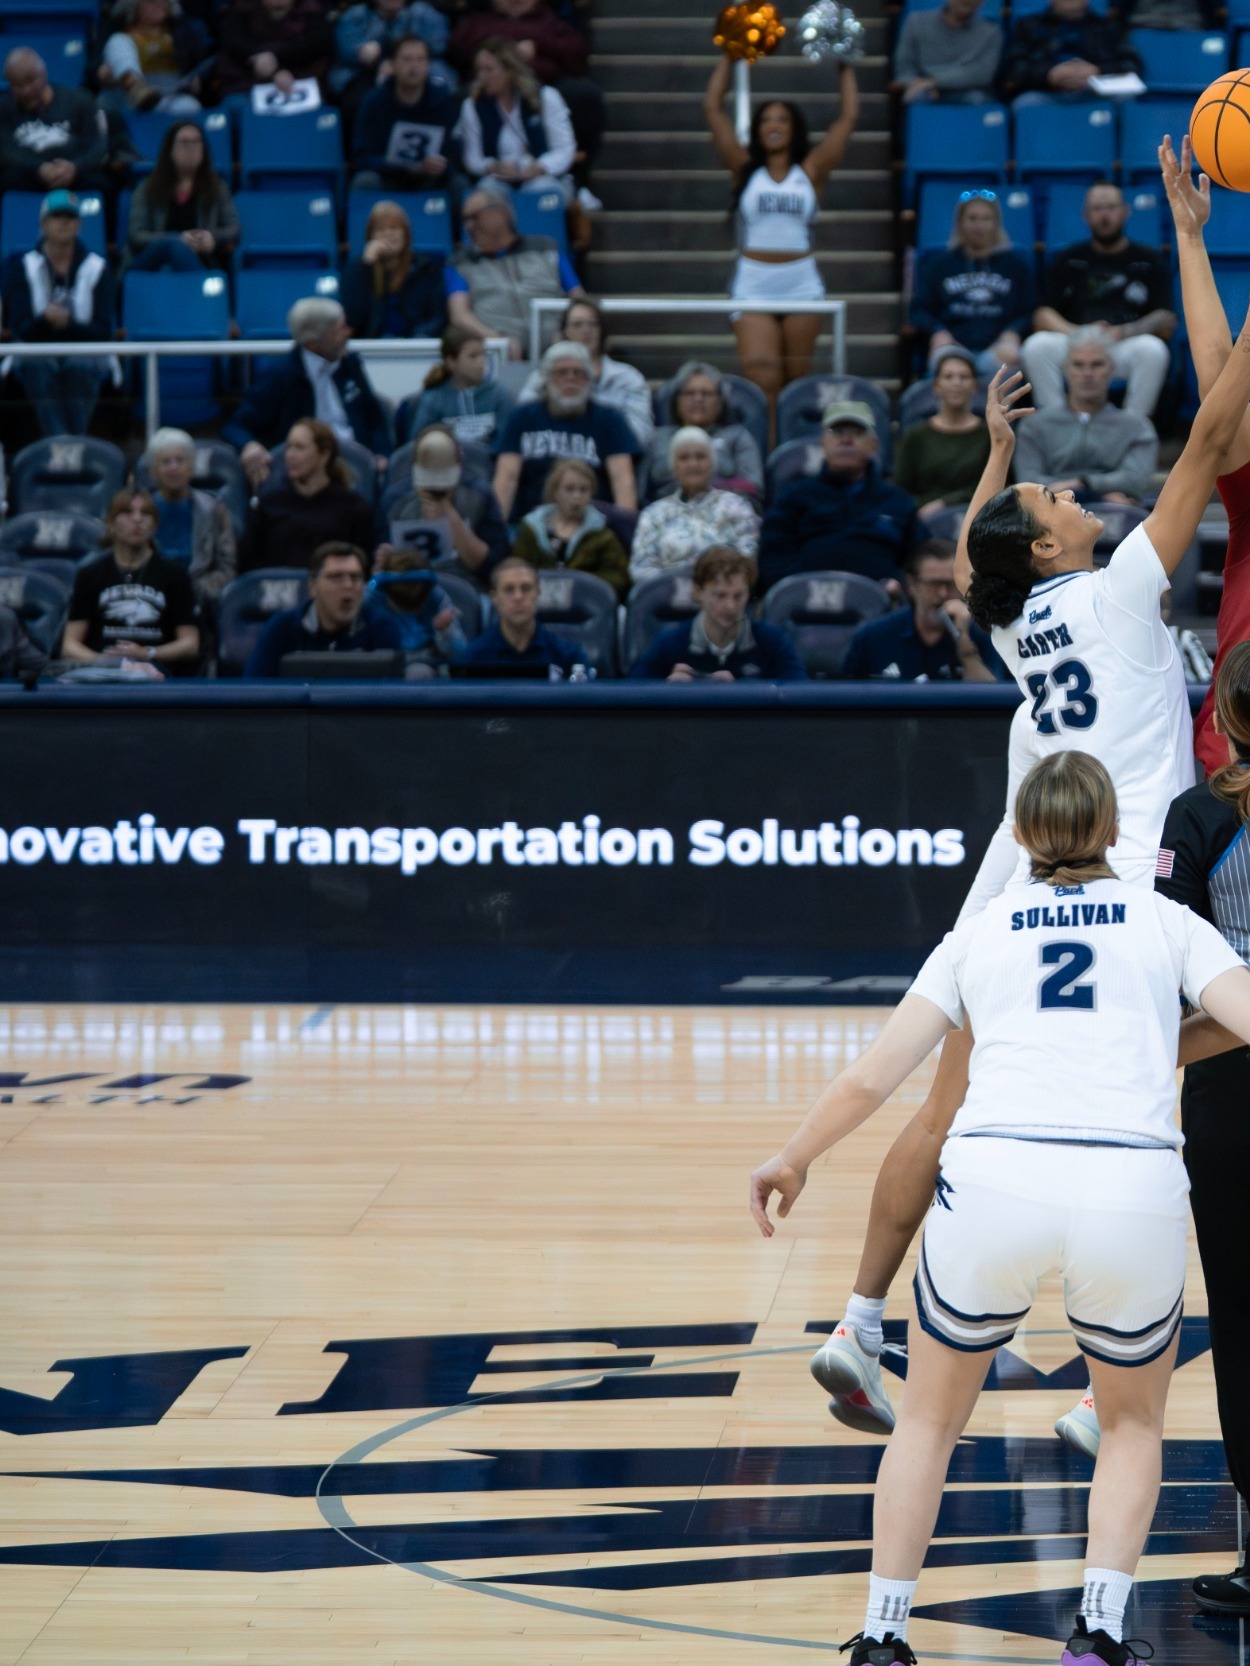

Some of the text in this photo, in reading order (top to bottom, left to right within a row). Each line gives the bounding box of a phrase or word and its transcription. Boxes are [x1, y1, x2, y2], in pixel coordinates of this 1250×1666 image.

[521, 429, 601, 466] NEVADA
[98, 583, 166, 610] NEVADA
[1023, 656, 1100, 738] 23
[0, 814, 966, 874] ovative Transportation Solutions
[1010, 903, 1127, 931] SULLIVAN
[1036, 938, 1099, 1013] 2
